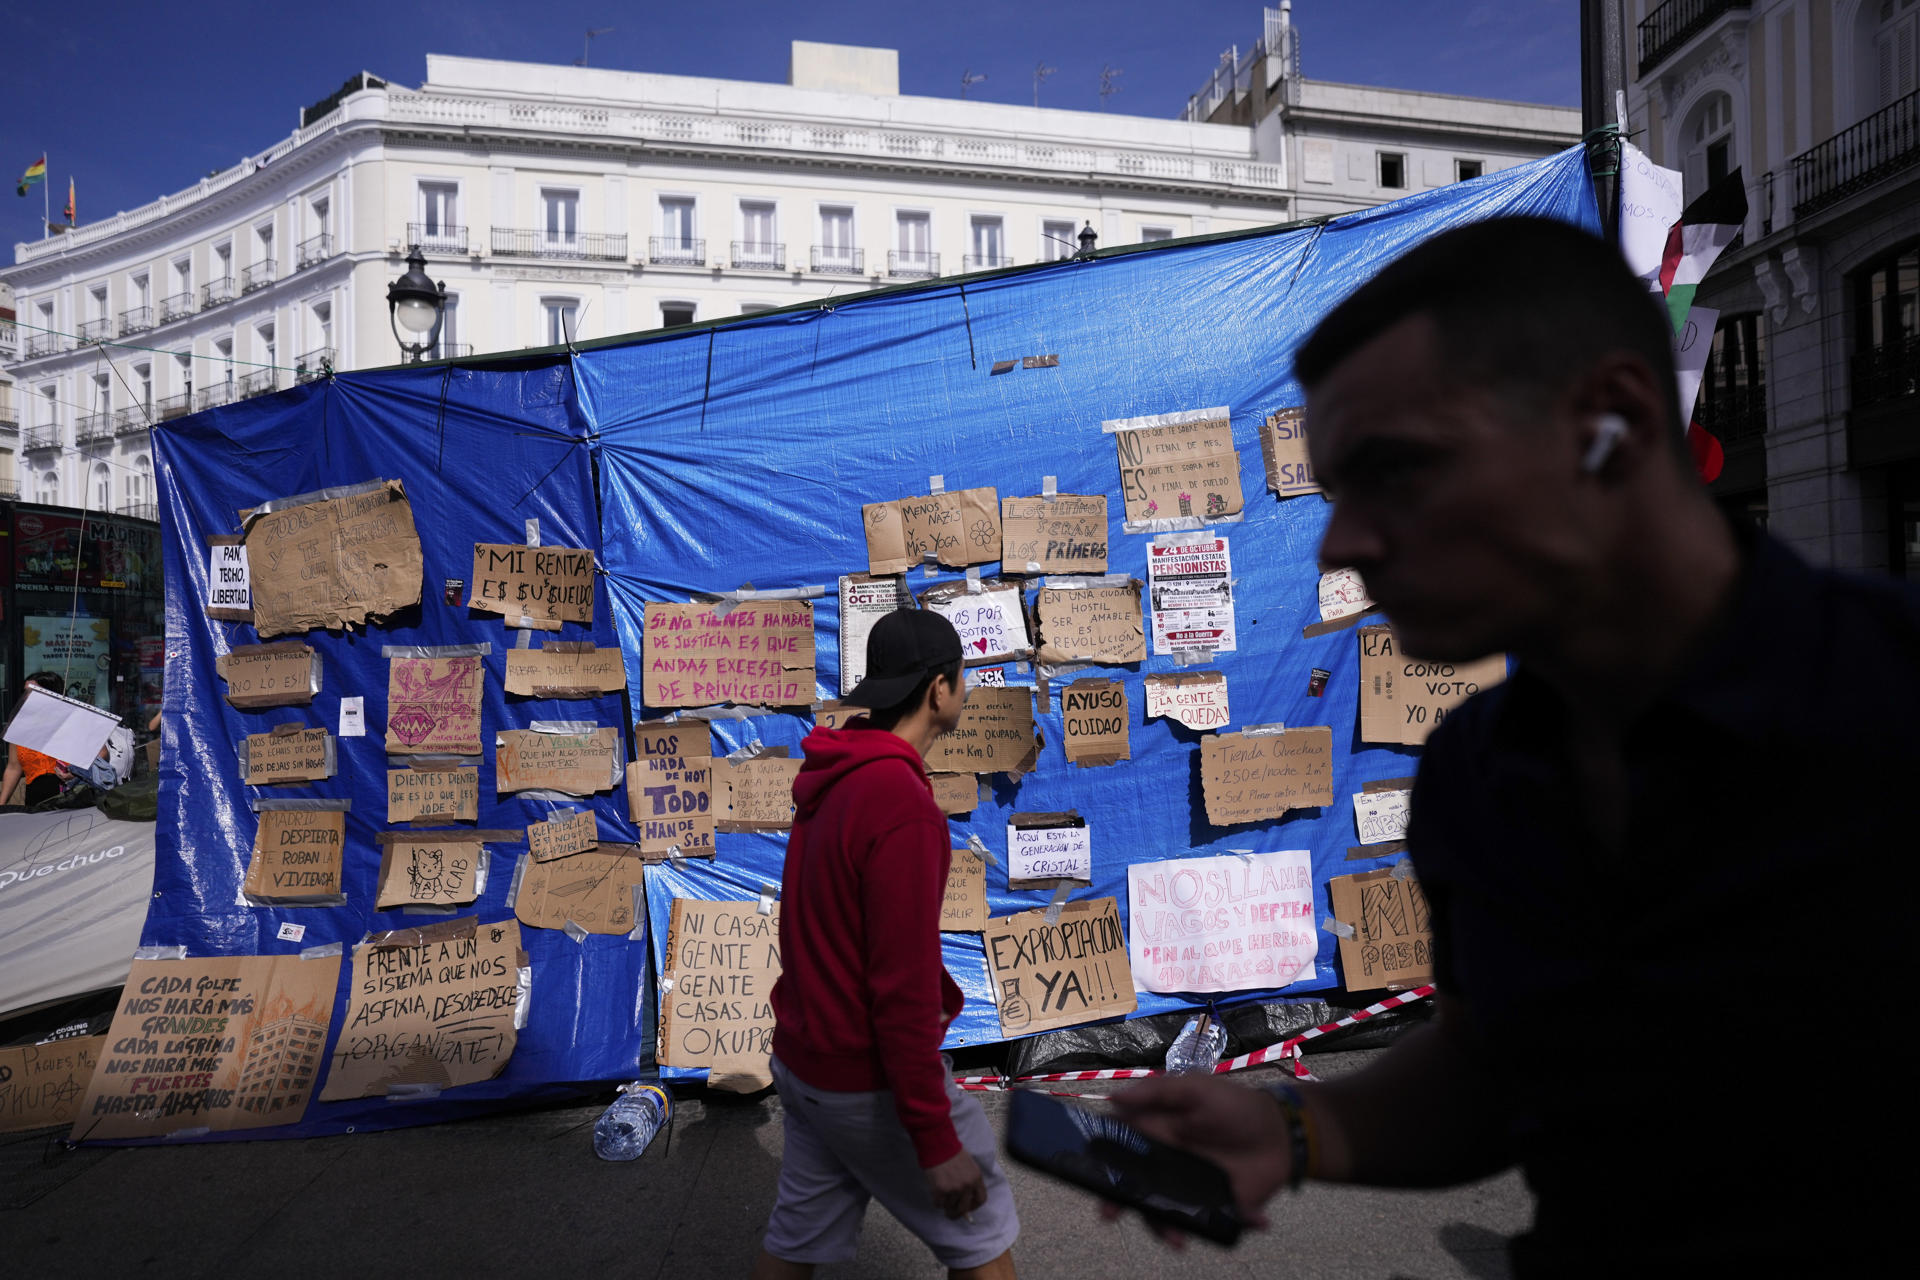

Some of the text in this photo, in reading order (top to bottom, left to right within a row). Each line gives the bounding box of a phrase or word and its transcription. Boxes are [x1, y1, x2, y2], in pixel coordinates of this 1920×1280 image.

[1117, 430, 1143, 467] NO
[1156, 443, 1181, 453] FINAL
[1123, 468, 1148, 502] ES
[902, 503, 940, 523] MENOS
[1009, 503, 1046, 519] LOS
[929, 532, 960, 552] YOGA
[1189, 543, 1218, 553] OCTUBRE
[223, 547, 241, 563] PAN,
[489, 549, 588, 577] MI RENTA
[1152, 554, 1200, 564] MANIFESTACIÓN
[219, 567, 245, 585] TECHO,
[1152, 560, 1227, 576] PENSIONISTAS
[211, 589, 249, 605] LIBERTAD.
[849, 586, 857, 594] 4
[1044, 590, 1132, 604] EN UNA CIUDAD
[848, 595, 874, 604] OCT
[1072, 603, 1110, 613] HOSTIL
[762, 613, 812, 628] HAMBRE
[977, 605, 1003, 622] POR
[1052, 612, 1131, 627] SER AMABLE
[1079, 626, 1092, 635] ES
[653, 635, 670, 649] DE
[738, 635, 760, 651] ES
[767, 636, 800, 654] QUE
[1054, 631, 1135, 649] REVOLUCIÓN
[652, 657, 782, 679] ANDAS EXCESO
[260, 678, 275, 689] LO
[658, 680, 685, 702] DE
[1425, 682, 1479, 696] VOTO
[1066, 690, 1122, 711] AYUSO
[1176, 692, 1214, 704] GENTE
[1181, 706, 1230, 725] QUEDA!
[1406, 704, 1427, 724] YO
[1068, 717, 1122, 736] CUIDAO
[304, 731, 326, 743] MONTE
[644, 735, 679, 756] LOS
[520, 750, 539, 760] QUE
[1218, 740, 1324, 763] Tienda Quechua
[250, 763, 264, 773] NOS
[305, 758, 326, 769] HOGAR
[649, 757, 686, 771] NADA
[395, 773, 476, 787] DIENTES DIENTES
[665, 769, 706, 783] DE HOY
[391, 791, 405, 804] QUE
[409, 792, 420, 801] ES
[424, 791, 434, 800] LO
[440, 790, 454, 801] QUE
[420, 803, 445, 815] JODE
[264, 812, 318, 828] MADRID
[280, 830, 339, 846] DESPIERTA
[645, 819, 694, 840] HAN DE
[1016, 831, 1039, 842] AQUÍ
[684, 832, 710, 847] SER
[282, 851, 320, 865] ROBAN
[1020, 843, 1069, 856] GENERACIÓN
[1033, 859, 1079, 873] CRISTAL
[273, 871, 336, 887] VIVIENDA
[443, 858, 468, 899] ACAB
[943, 908, 973, 919] SALIR
[684, 912, 705, 934] NI
[1134, 907, 1229, 945] VAGOS
[991, 901, 1123, 971] EXPROPIACIÓN
[1204, 938, 1243, 958] QUE
[1248, 932, 1312, 951] HEREDA
[366, 938, 477, 977] FRENTE A UN
[682, 939, 752, 970] GENTE
[364, 956, 506, 994] SISTEMA QUE NOS
[140, 976, 242, 996] CADA GOLPE
[680, 974, 754, 997] GENTE
[123, 999, 163, 1015] NOS
[217, 993, 255, 1015] MÁS
[351, 985, 517, 1029] ASFIXIA, DESOBEDECE
[677, 1002, 748, 1022] CASAS.
[56, 1022, 88, 1035] COOLING
[141, 1016, 229, 1038] GRANDES
[113, 1036, 236, 1057] CADA LÁGRIMA
[105, 1059, 139, 1074] NOS
[190, 1054, 223, 1072] MÁS
[130, 1073, 213, 1093] FUERTES
[92, 1094, 157, 1116] HASTA
